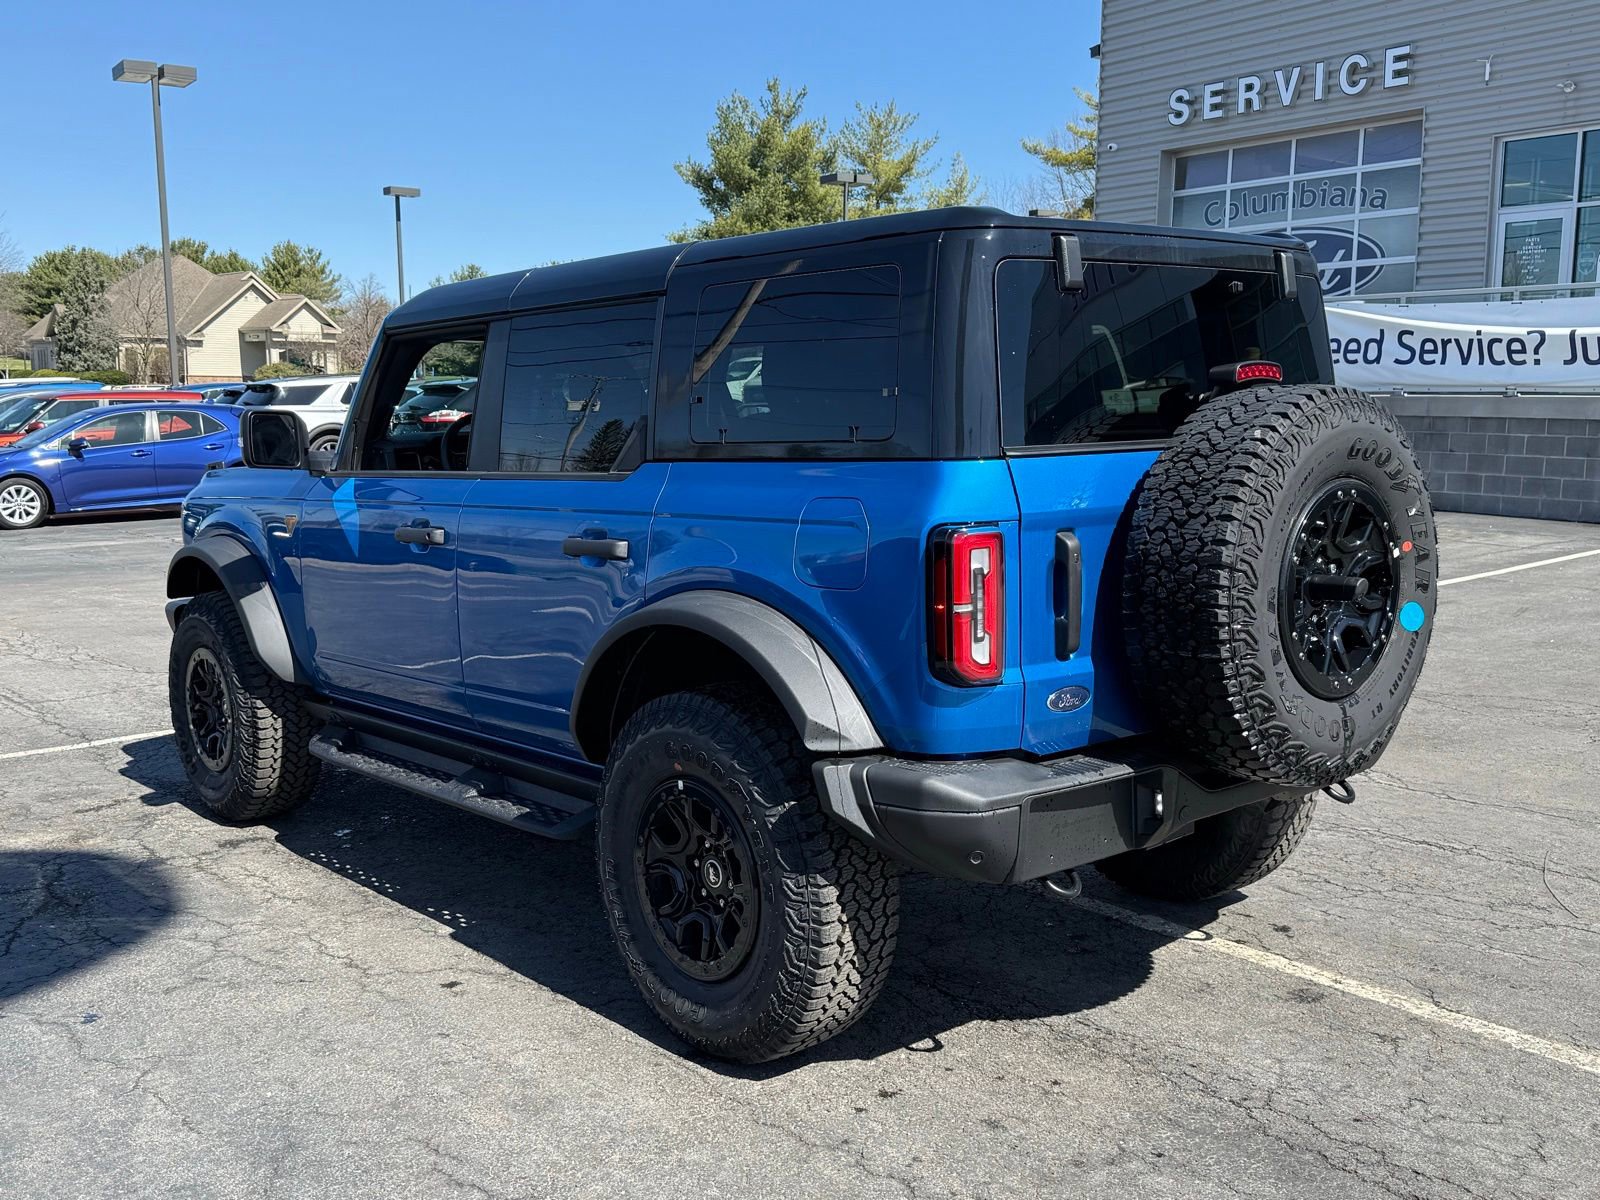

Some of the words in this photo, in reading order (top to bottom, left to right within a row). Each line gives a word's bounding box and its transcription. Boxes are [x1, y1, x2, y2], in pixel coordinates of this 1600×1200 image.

[1167, 43, 1413, 127] SERVICE
[1204, 181, 1389, 226] Columbiana
[1330, 328, 1386, 365] eed
[1392, 329, 1547, 366] Service?
[1563, 329, 1600, 366] Ju
[1388, 631, 1419, 699] ERRITORY
